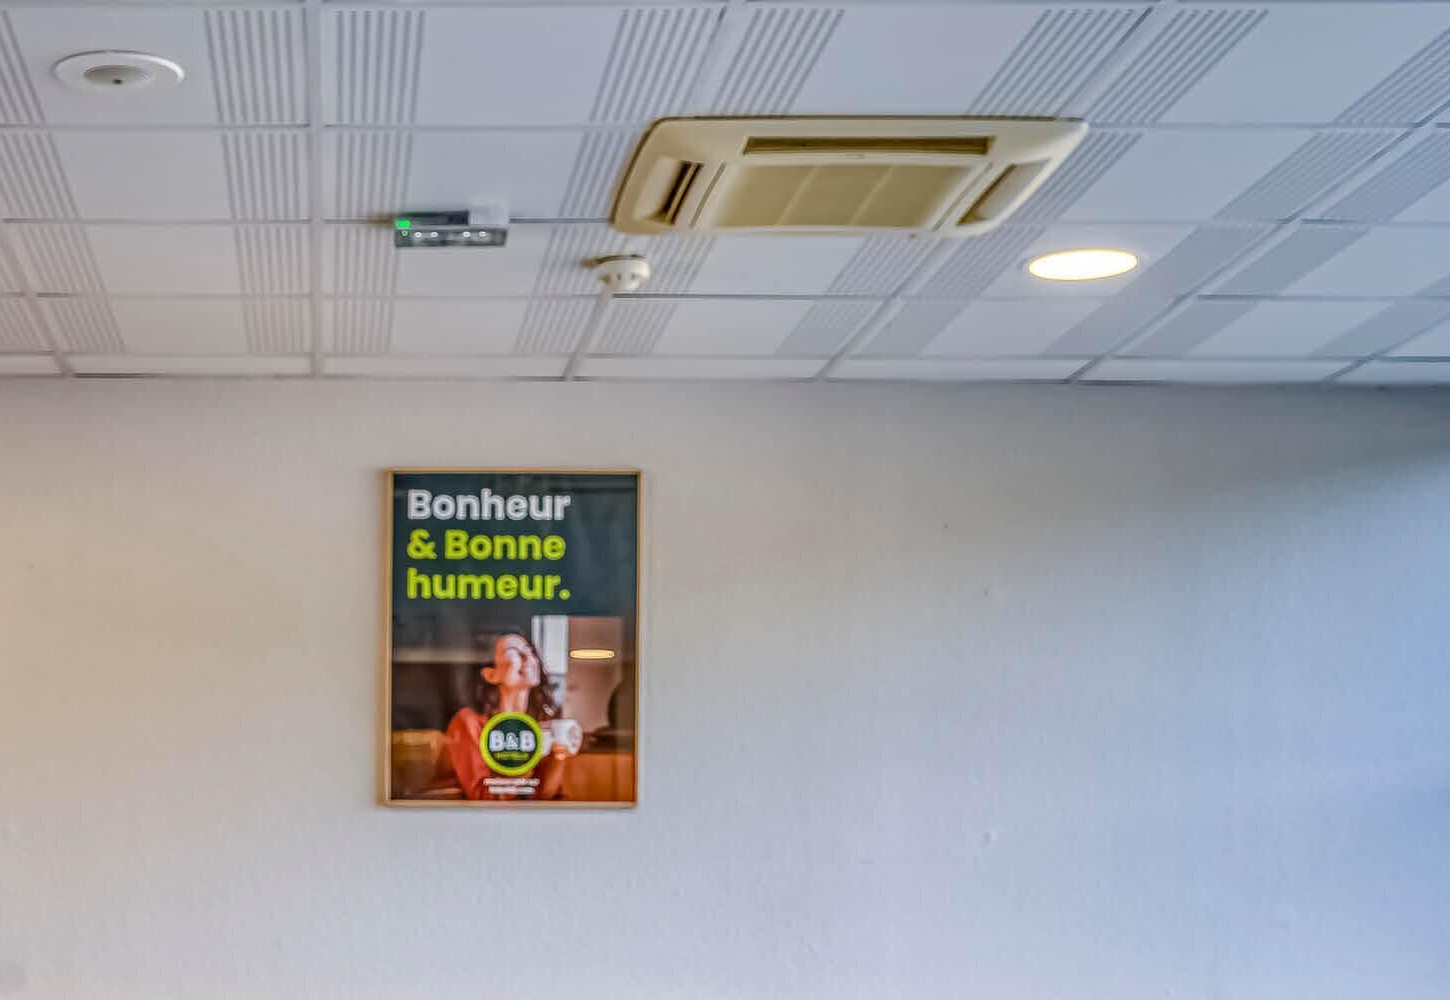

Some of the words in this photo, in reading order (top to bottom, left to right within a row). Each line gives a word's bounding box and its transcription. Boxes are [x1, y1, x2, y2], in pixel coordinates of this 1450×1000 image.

[407, 488, 571, 520] Bonheur
[407, 529, 437, 560] &
[444, 529, 566, 560] Bonne
[407, 568, 571, 600] humeur.
[488, 730, 536, 752] B&B
